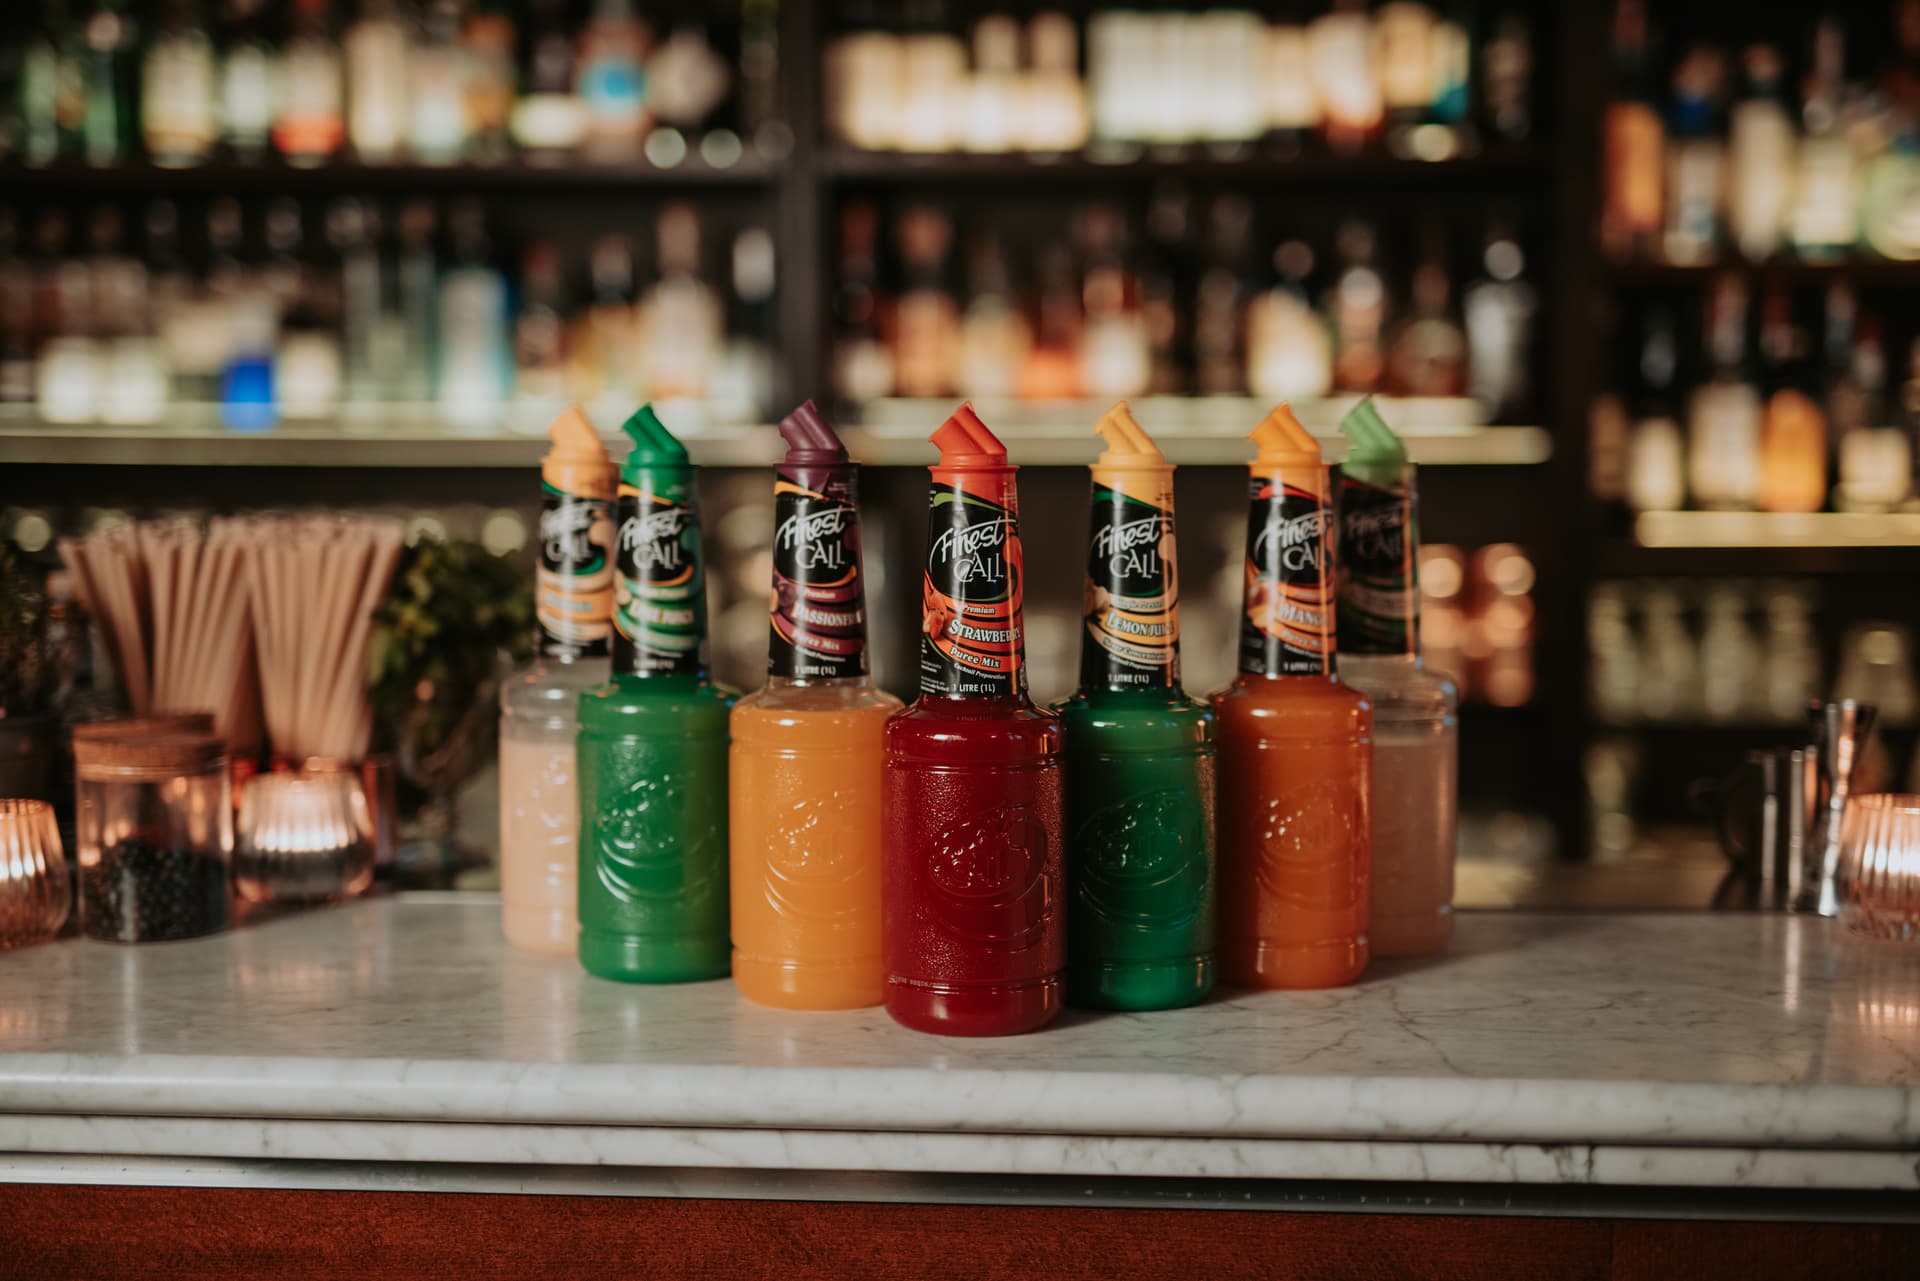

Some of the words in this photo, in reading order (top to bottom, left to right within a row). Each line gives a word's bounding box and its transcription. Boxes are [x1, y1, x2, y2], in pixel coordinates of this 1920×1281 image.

[779, 505, 850, 550] Finest
[938, 516, 1010, 563] Finest
[1096, 514, 1165, 560] Finest
[632, 541, 683, 570] CALL
[795, 539, 845, 569] CALL
[953, 549, 1004, 583] CALL
[1109, 549, 1160, 579] CALL
[1283, 542, 1327, 571] CAL
[961, 604, 995, 614] Premium
[1107, 611, 1148, 636] LEMON
[820, 666, 837, 676] (1L)
[950, 646, 980, 664] Puree
[981, 657, 1000, 668] Mix
[959, 684, 979, 692] LITRE
[980, 684, 996, 693] (1L)
[1133, 674, 1150, 684] (1L)
